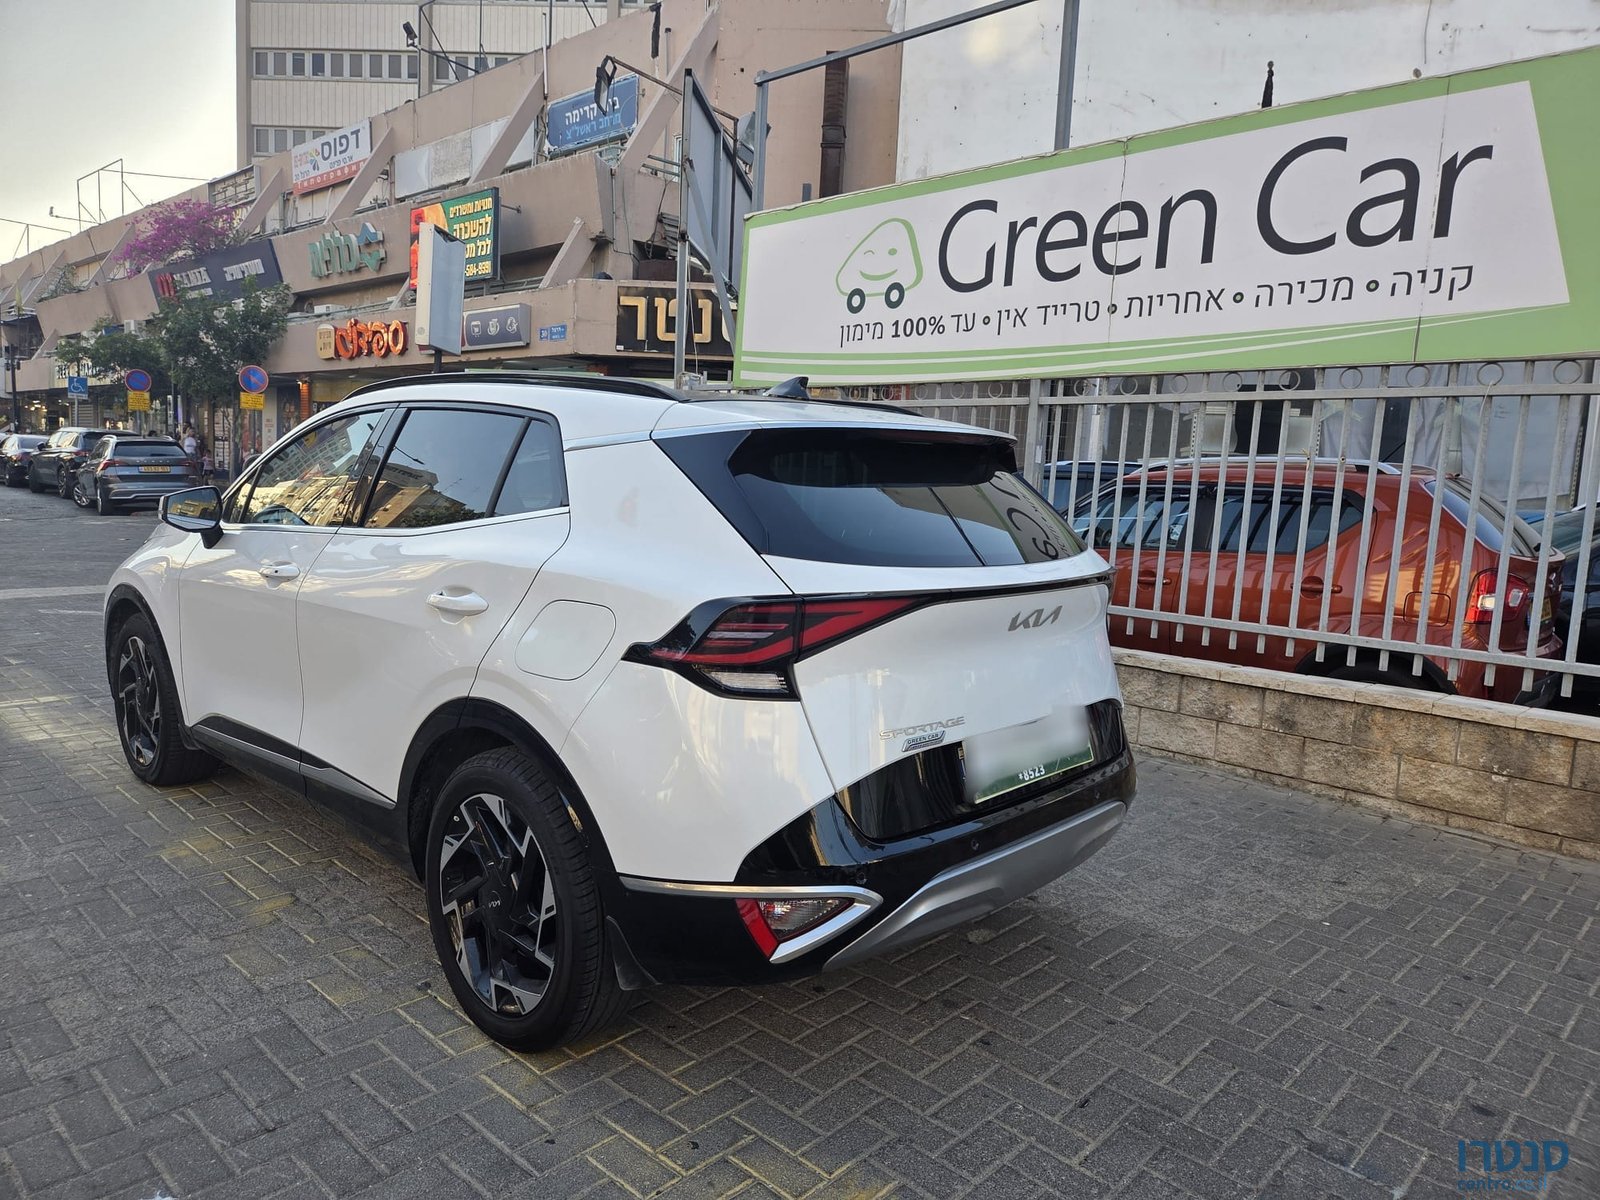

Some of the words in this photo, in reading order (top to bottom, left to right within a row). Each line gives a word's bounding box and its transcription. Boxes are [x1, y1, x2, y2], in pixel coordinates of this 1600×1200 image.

[565, 103, 598, 125] קדימה
[599, 112, 621, 129] מרחב
[320, 128, 361, 161] דפוס
[474, 197, 493, 213] חנויות
[937, 188, 1218, 293] Green
[1256, 135, 1494, 256] Car
[453, 213, 492, 240] להשכרה
[477, 237, 492, 257] לכל
[1254, 275, 1354, 307] מכירה
[1390, 265, 1474, 301] קניה
[1037, 300, 1100, 325] טרייד
[1124, 287, 1225, 318] אחריות
[891, 315, 946, 338] 100%
[951, 312, 976, 333] עד
[997, 307, 1028, 335] אין
[840, 321, 884, 348] מימון
[1008, 605, 1063, 632] KIA
[879, 716, 966, 742] SPORTAGE
[907, 736, 927, 745] GREEN
[928, 732, 940, 741] CAR
